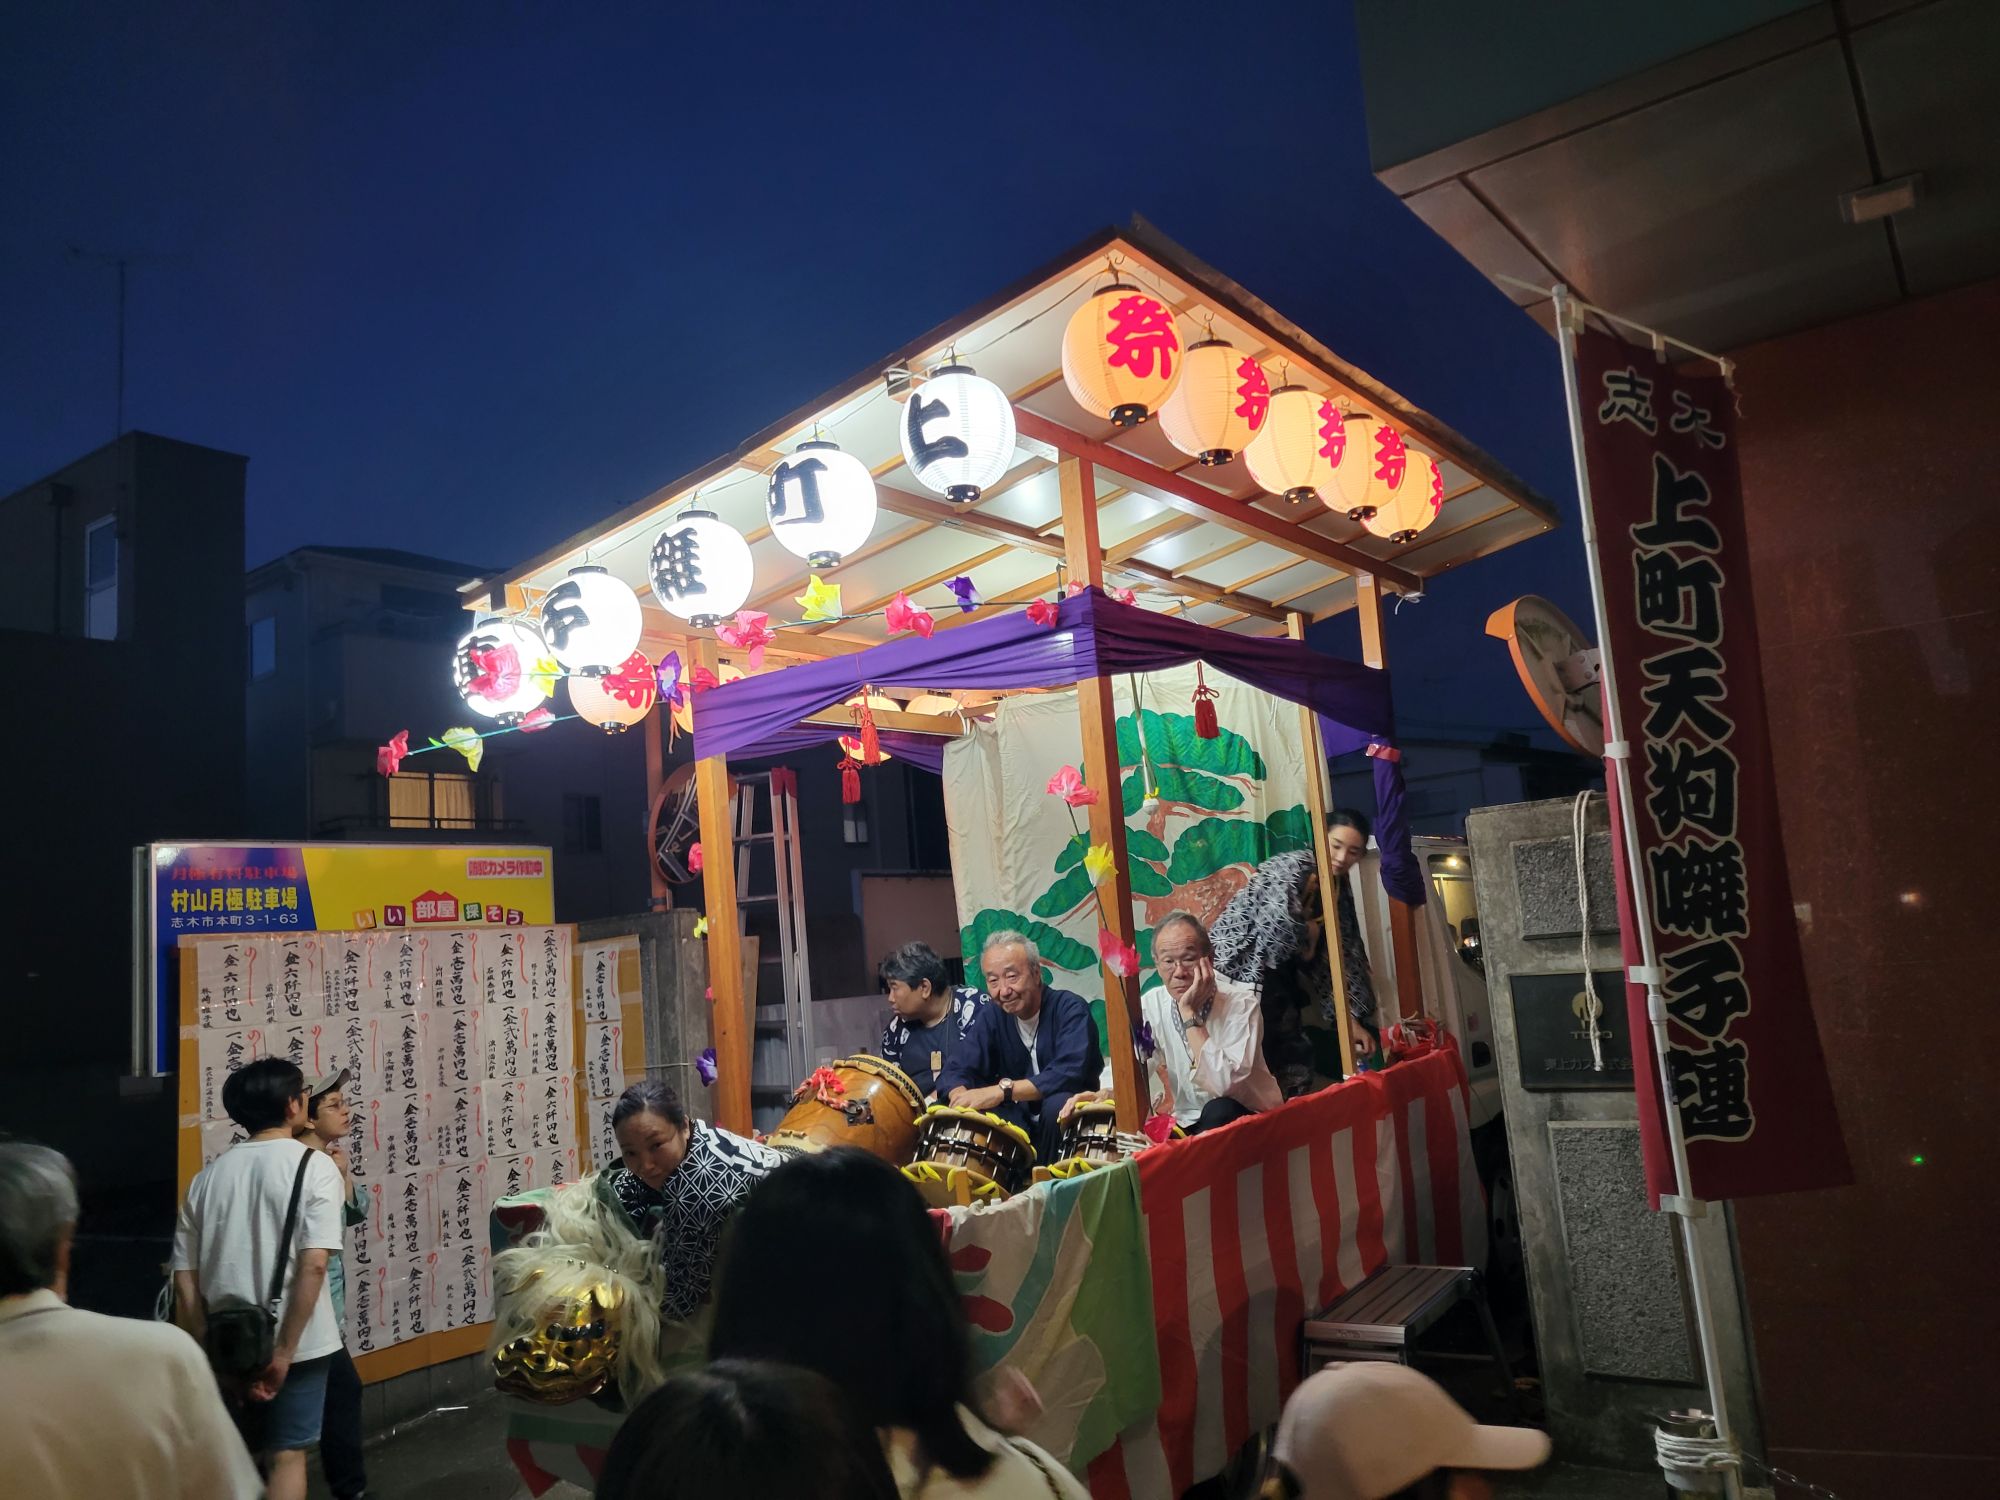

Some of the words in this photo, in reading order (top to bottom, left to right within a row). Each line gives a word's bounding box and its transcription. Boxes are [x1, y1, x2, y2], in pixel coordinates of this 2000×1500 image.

[1106, 295, 1178, 380] 祭
[1630, 450, 1755, 1142] 上町天狗囃子連
[171, 886, 298, 913] 村山月極駐車場
